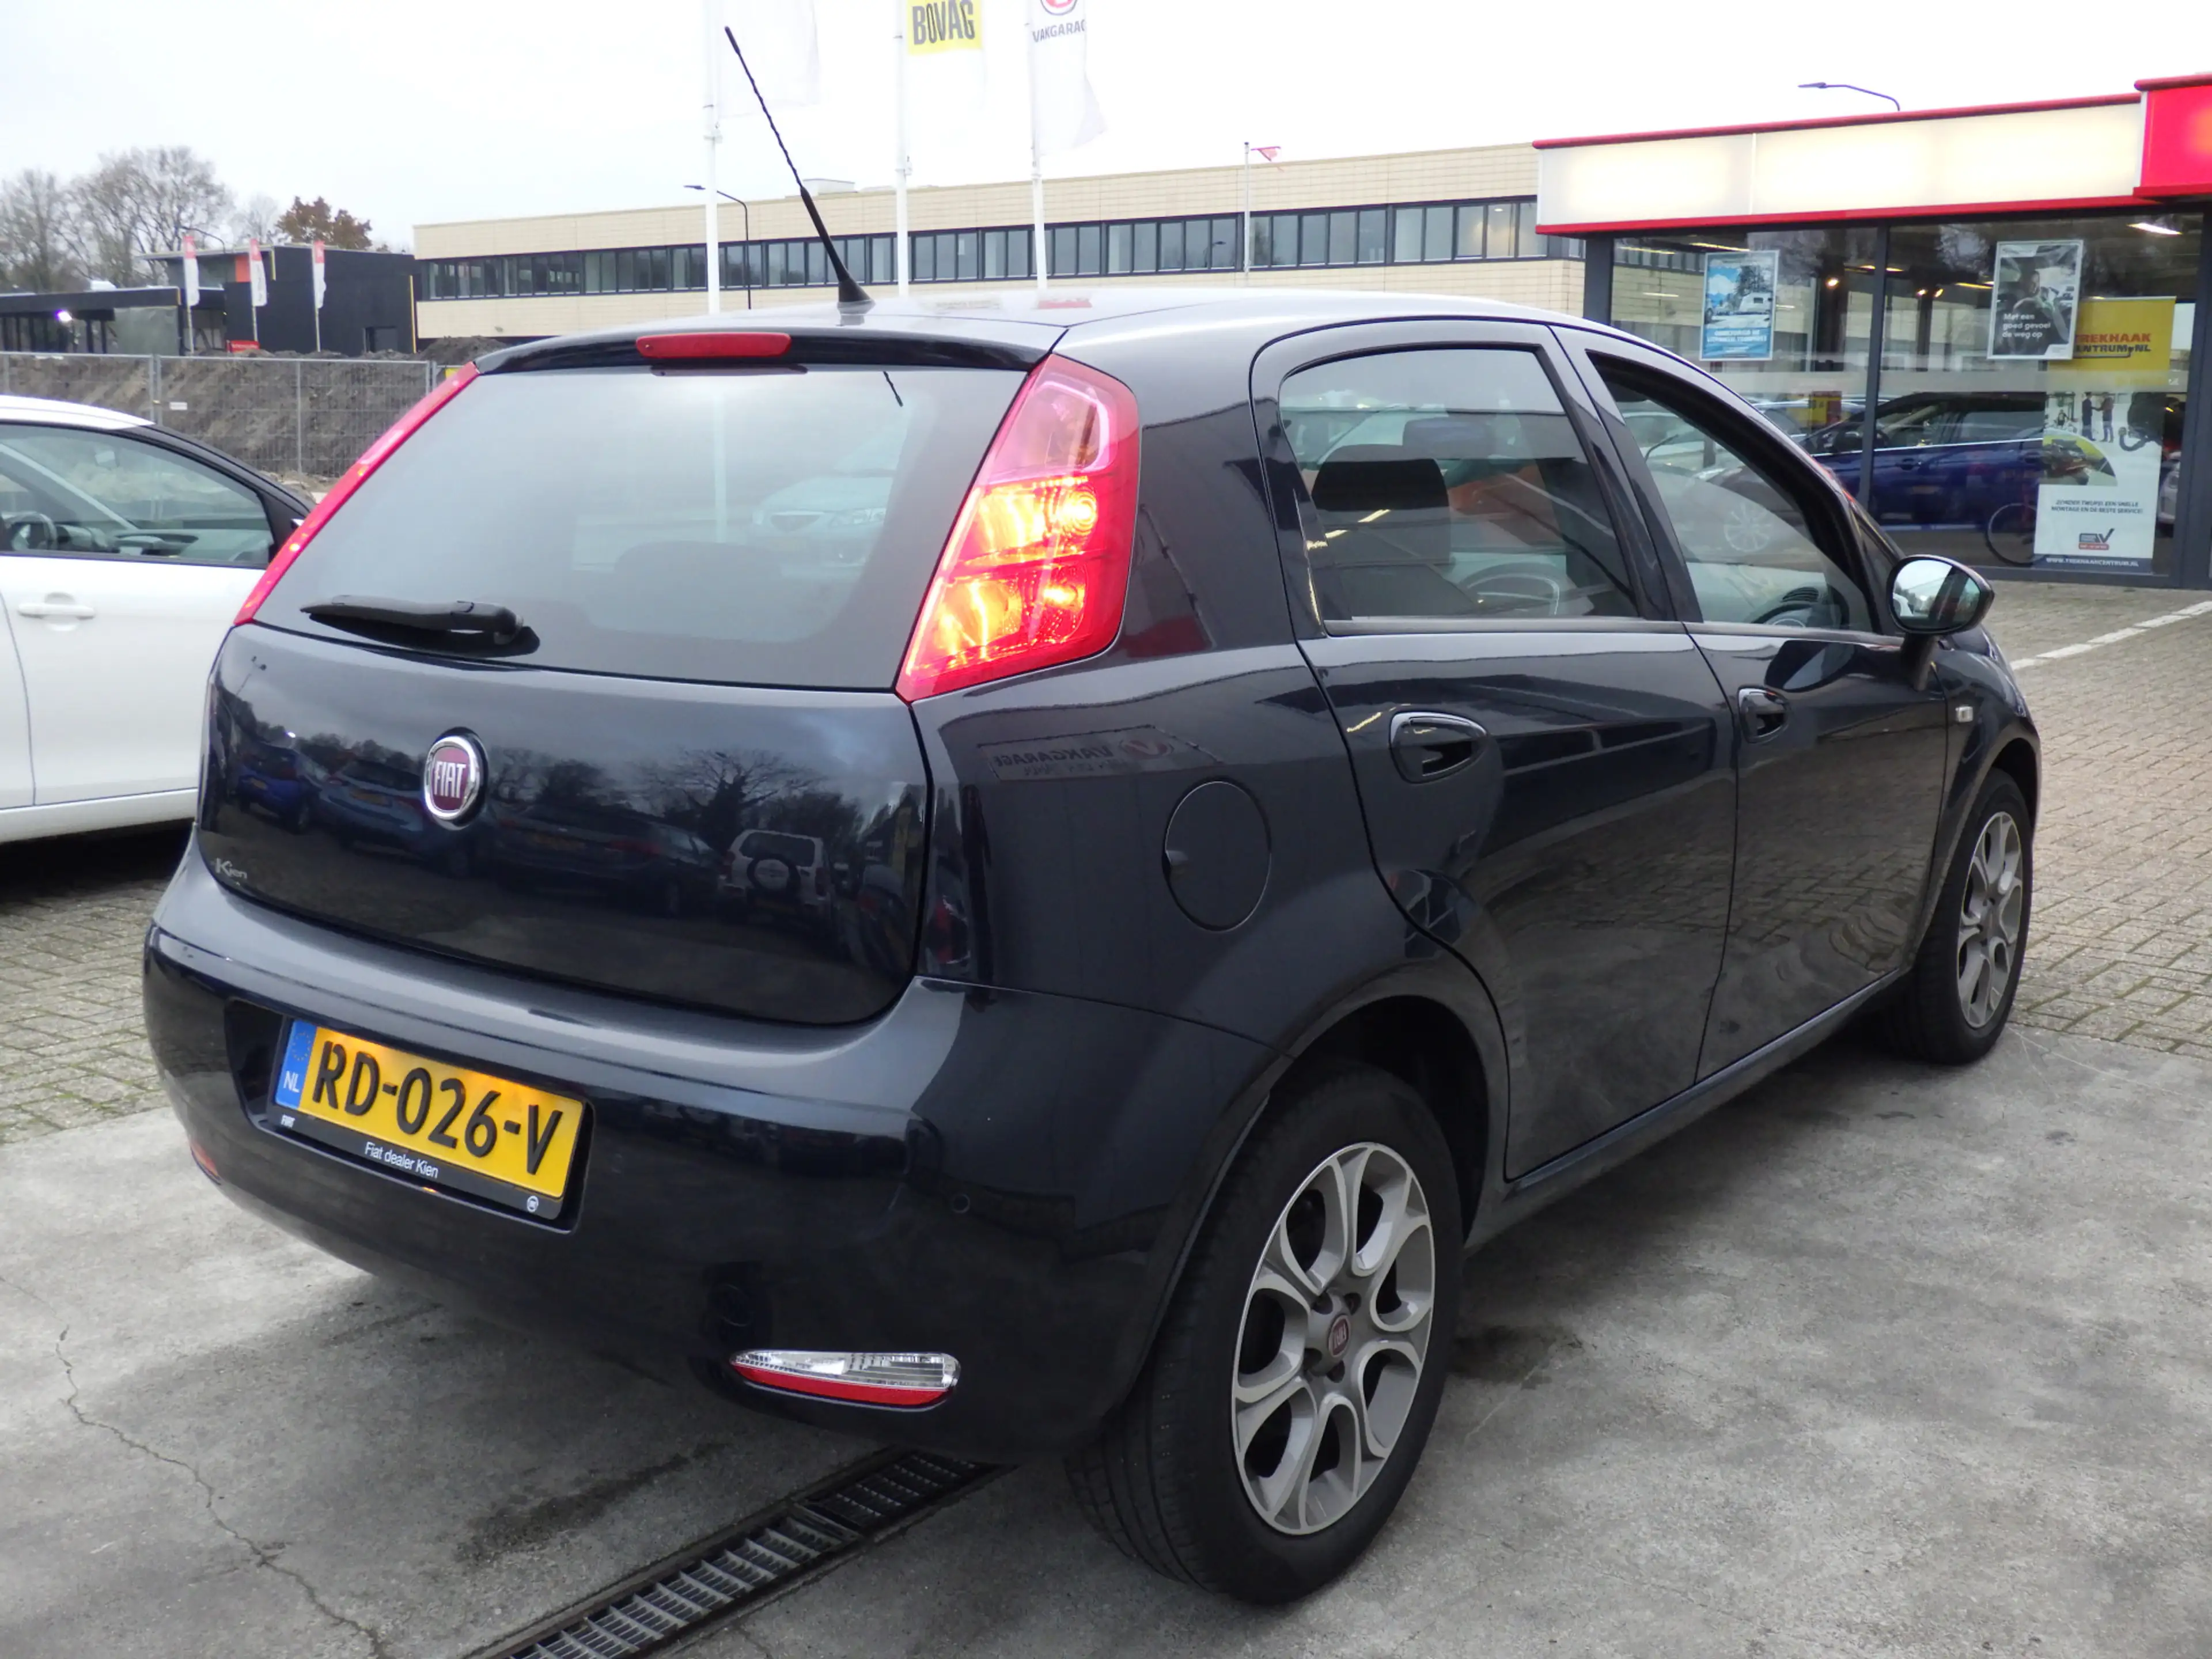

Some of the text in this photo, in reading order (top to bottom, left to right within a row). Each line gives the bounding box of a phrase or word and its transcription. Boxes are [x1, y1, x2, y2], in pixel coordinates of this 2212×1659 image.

[912, 0, 975, 45] BOVAG
[2003, 322, 2051, 331] goed gevoel
[2032, 332, 2043, 340] op
[2075, 344, 2152, 353] ENTRUM.NL
[434, 760, 467, 798] FIAT
[215, 857, 248, 879] Kien
[283, 1070, 300, 1093] NL
[312, 1040, 563, 1176] RD-026-V
[364, 1141, 439, 1179] Fiat dealer Kien
